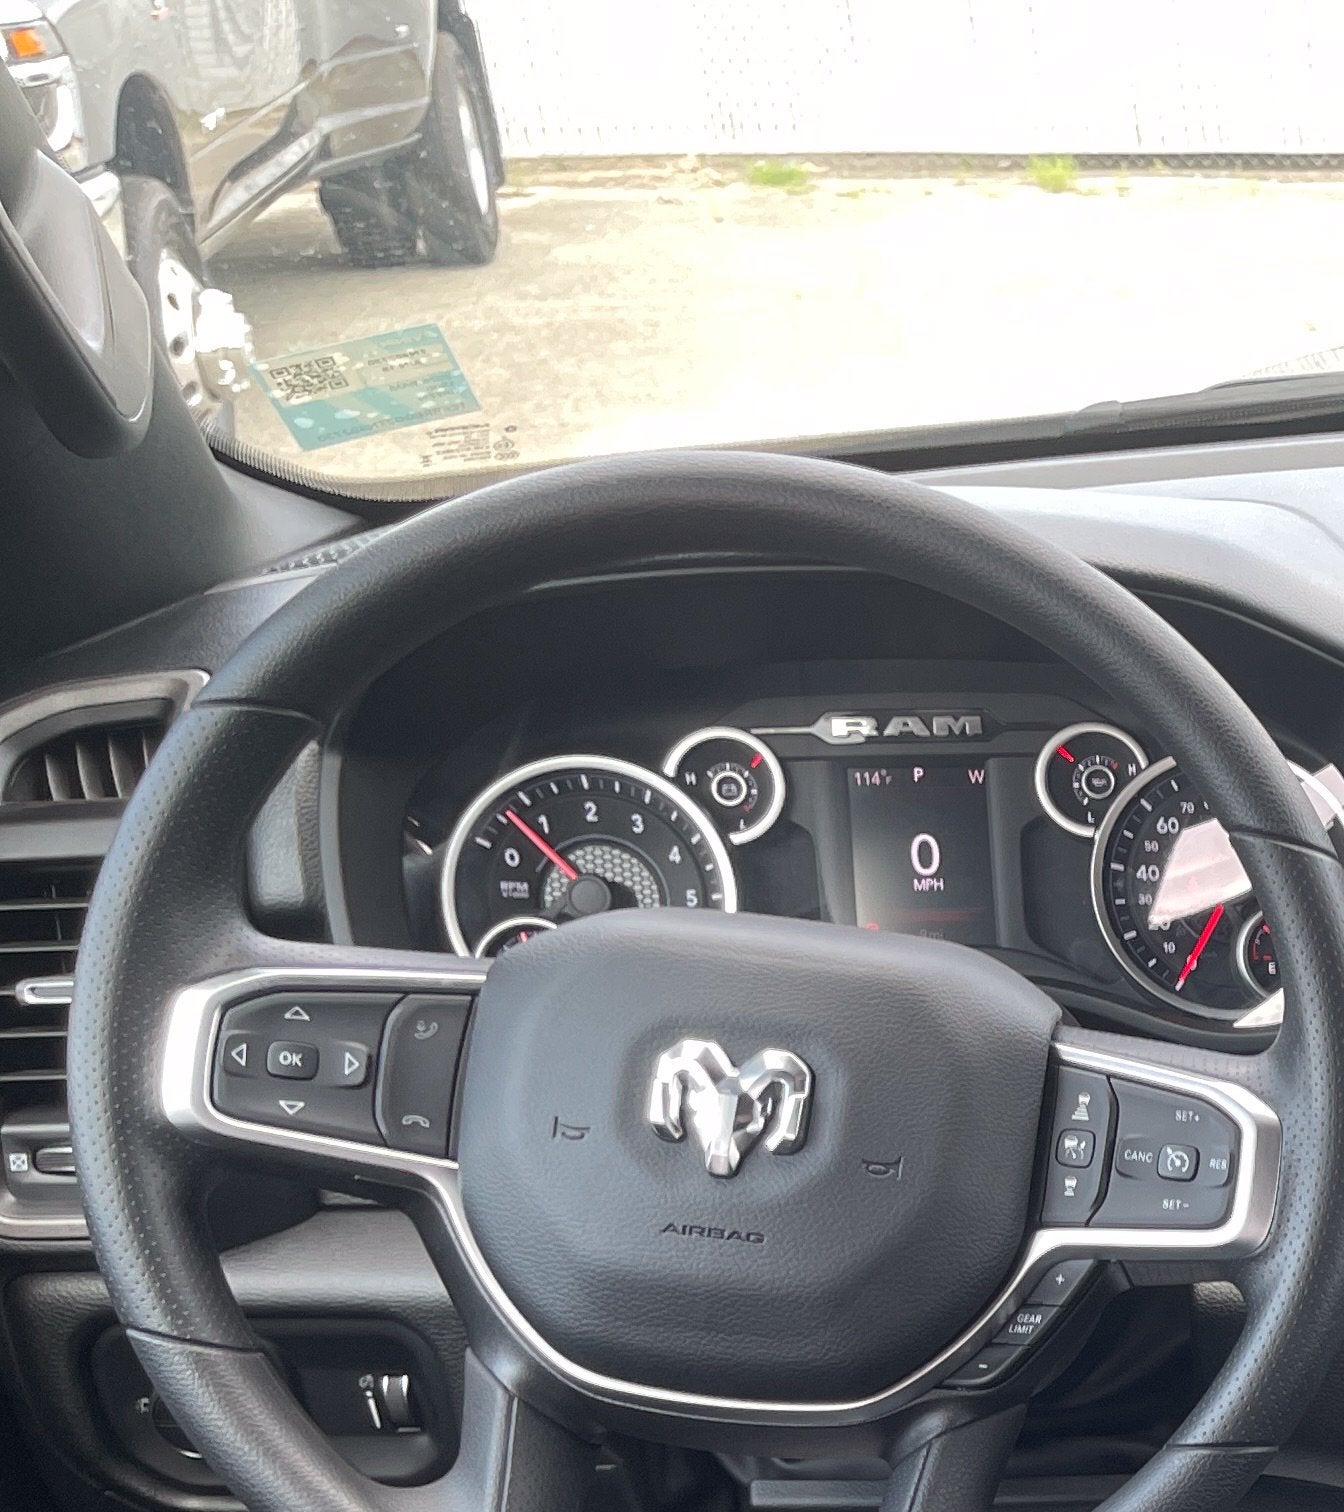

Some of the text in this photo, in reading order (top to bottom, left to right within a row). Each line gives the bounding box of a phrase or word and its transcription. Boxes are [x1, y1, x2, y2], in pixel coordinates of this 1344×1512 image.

[831, 715, 982, 738] RAM
[913, 766, 924, 783] P
[968, 769, 985, 785] W
[583, 801, 598, 823] 2
[1181, 801, 1194, 814] 70
[538, 814, 550, 834] 1
[631, 813, 645, 834] 3
[1156, 816, 1179, 834] 60
[504, 848, 520, 868] 0
[668, 845, 681, 865] 4
[910, 832, 940, 877] 0
[1136, 864, 1160, 882] 40
[913, 877, 944, 891] MPH
[686, 890, 698, 907] 5
[1164, 942, 1175, 953] 10
[279, 1051, 302, 1066] OK
[1124, 1149, 1153, 1164] CANC
[662, 1222, 765, 1244] AIRBAG
[1017, 1313, 1042, 1324] GEAR
[1009, 1324, 1034, 1334] LIMIT
